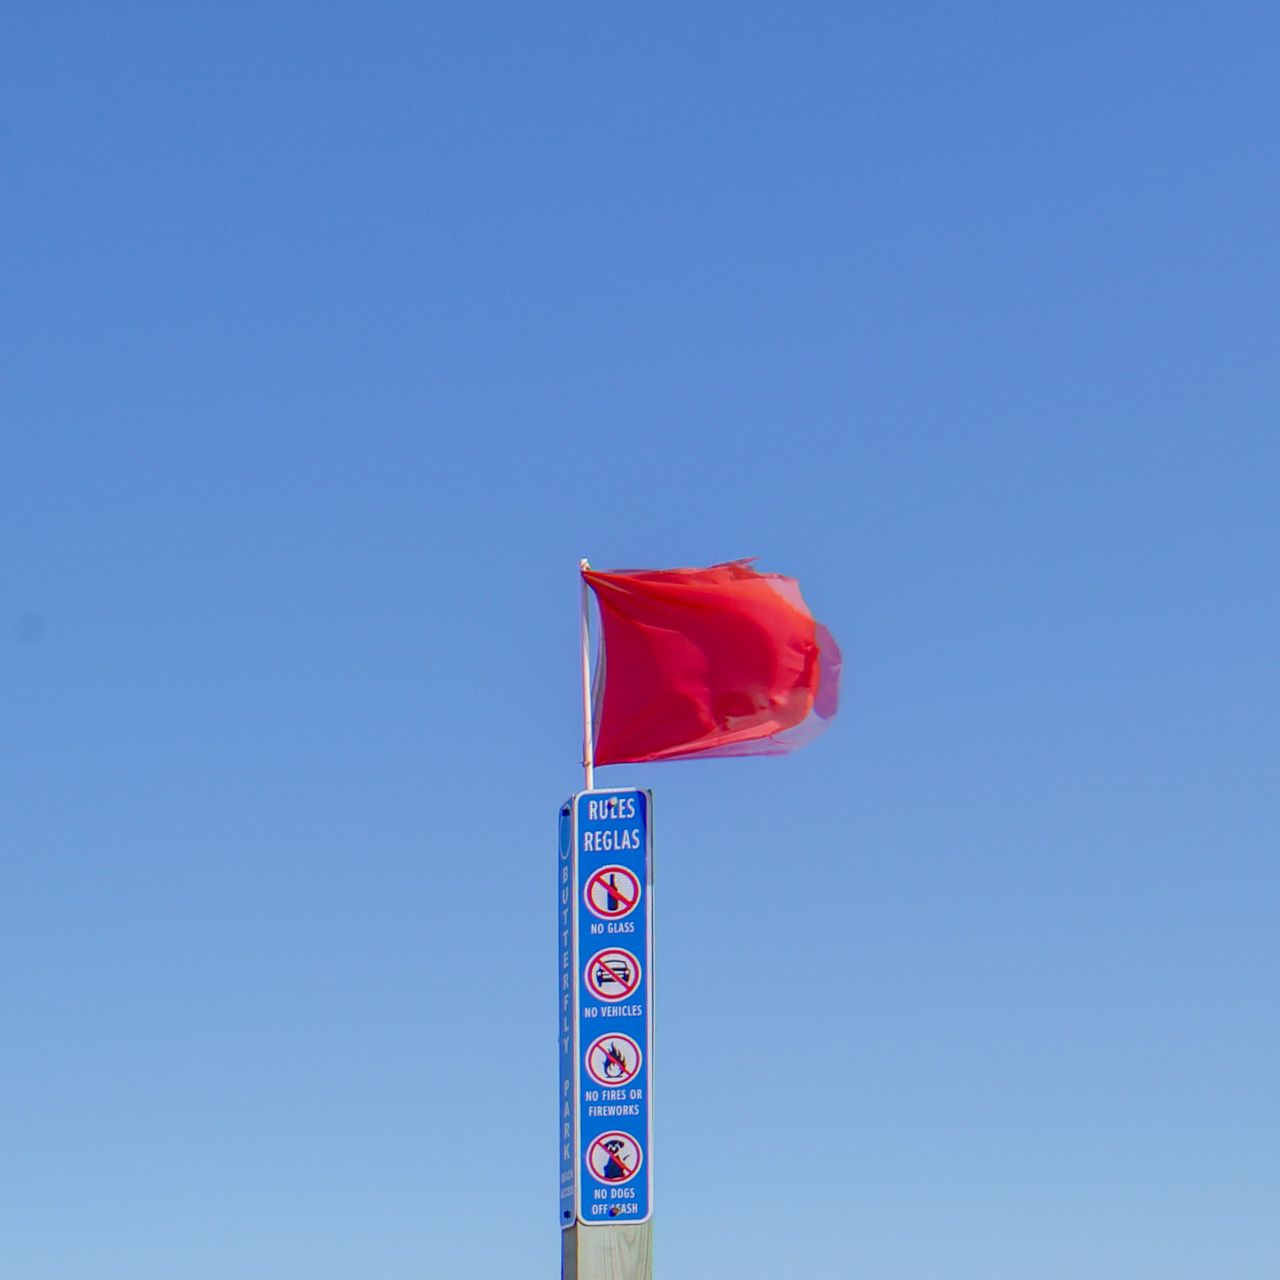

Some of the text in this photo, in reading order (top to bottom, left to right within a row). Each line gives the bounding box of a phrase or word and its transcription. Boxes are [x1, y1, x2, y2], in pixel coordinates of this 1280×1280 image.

[589, 797, 635, 820] RULES
[584, 829, 640, 851] REGLAS
[590, 921, 635, 935] NO GLASS
[562, 866, 570, 1053] BUTTERFLY
[584, 1005, 643, 1019] NO VEHICLES
[585, 1088, 643, 1102] NO FIRES OR
[588, 1104, 640, 1117] FIREWORKS
[594, 1187, 635, 1200] NO DOGS
[592, 1203, 608, 1215] OFF
